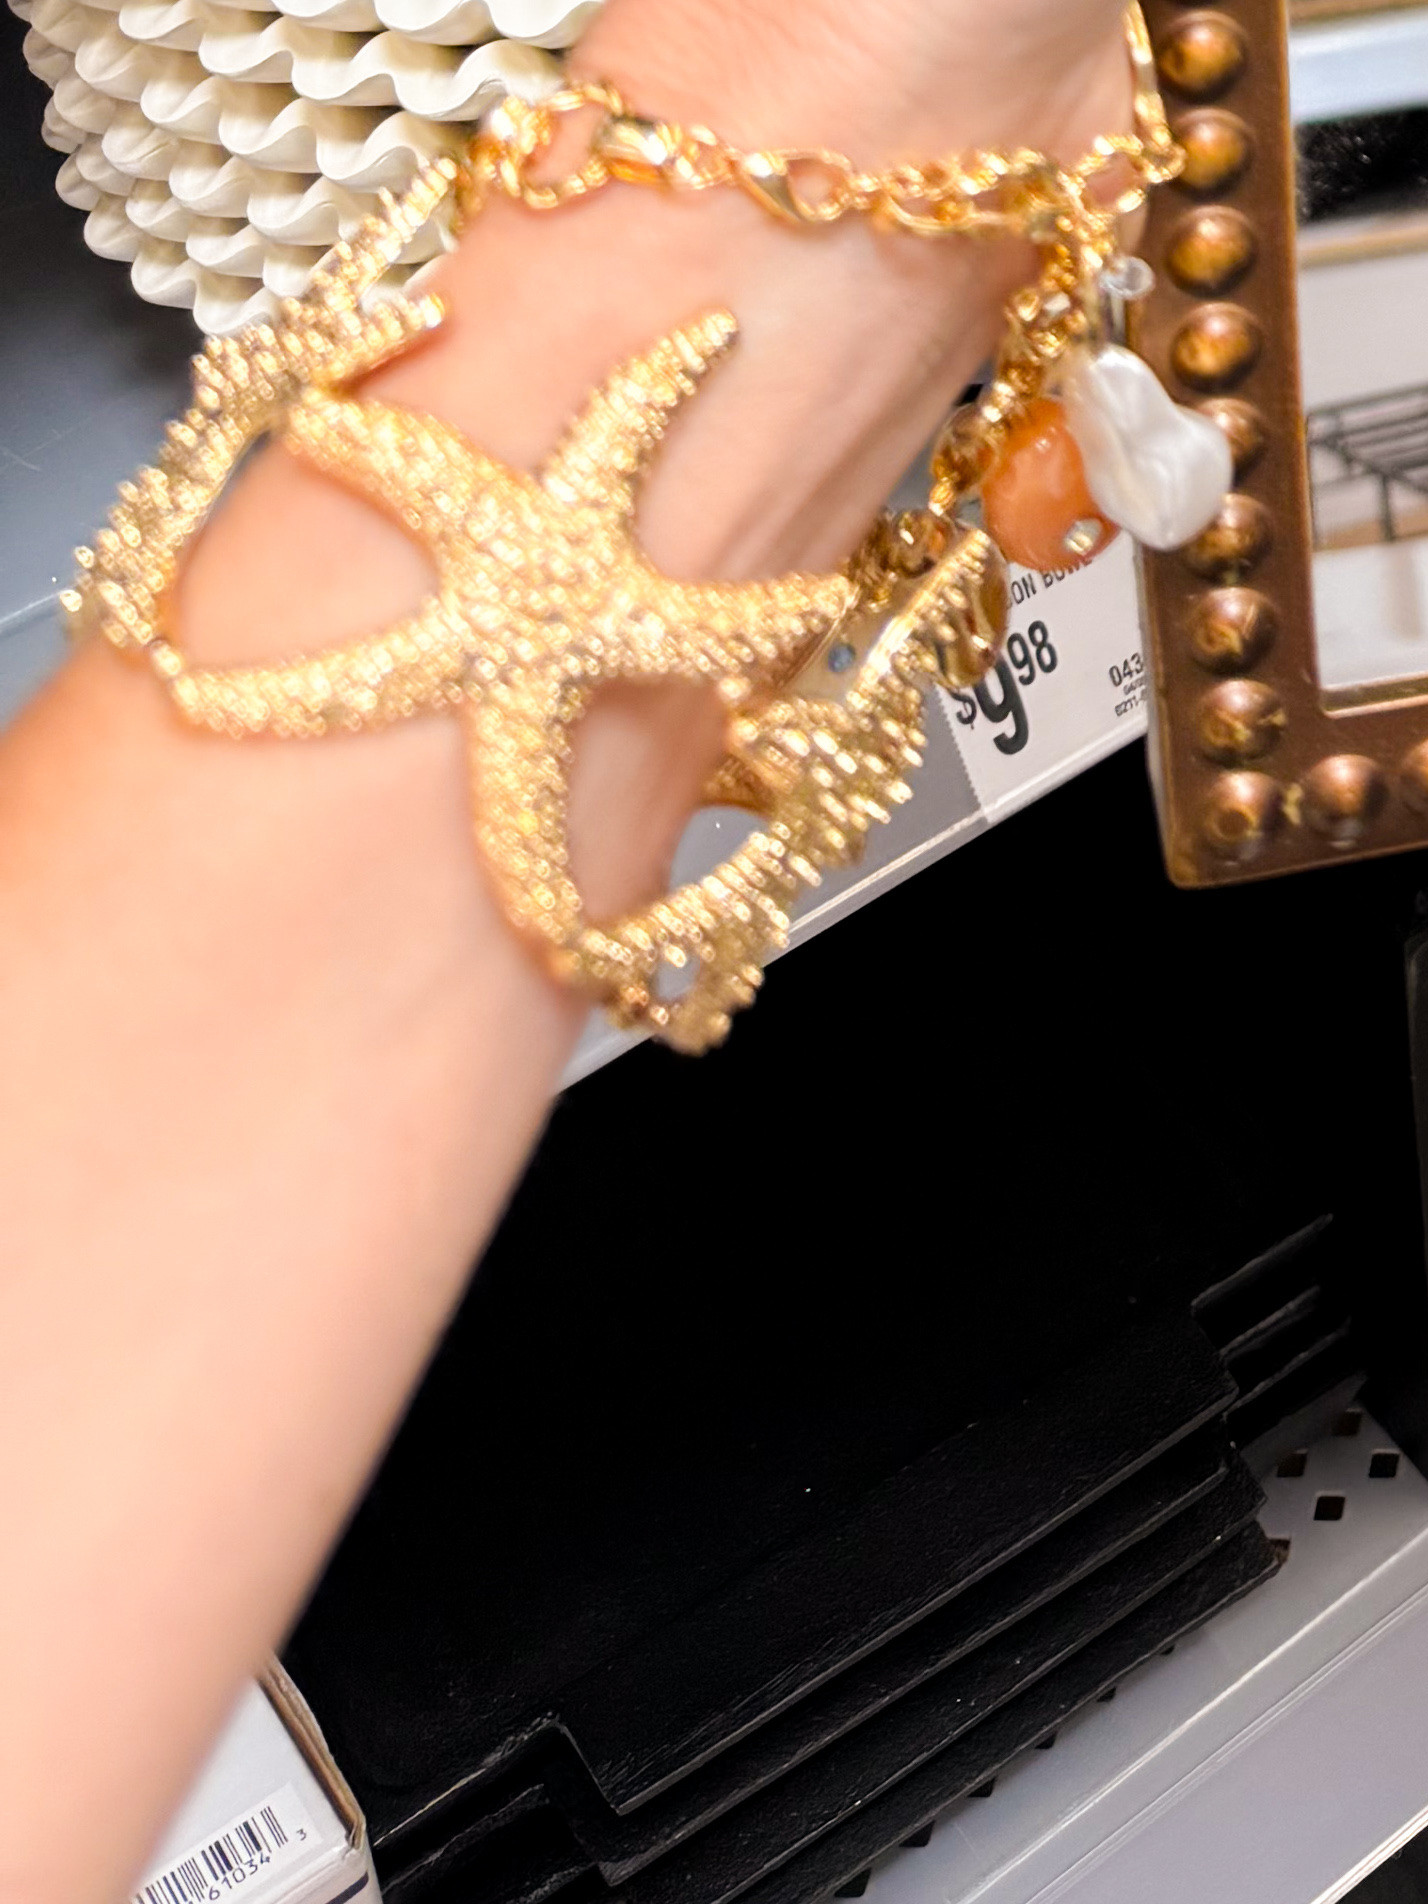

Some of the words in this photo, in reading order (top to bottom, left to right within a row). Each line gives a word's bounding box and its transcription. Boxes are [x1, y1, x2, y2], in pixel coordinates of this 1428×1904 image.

[1009, 572, 1038, 607] ON
[1108, 652, 1144, 688] 043
[296, 1828, 308, 1843] 3
[207, 1850, 272, 1902] 61034
